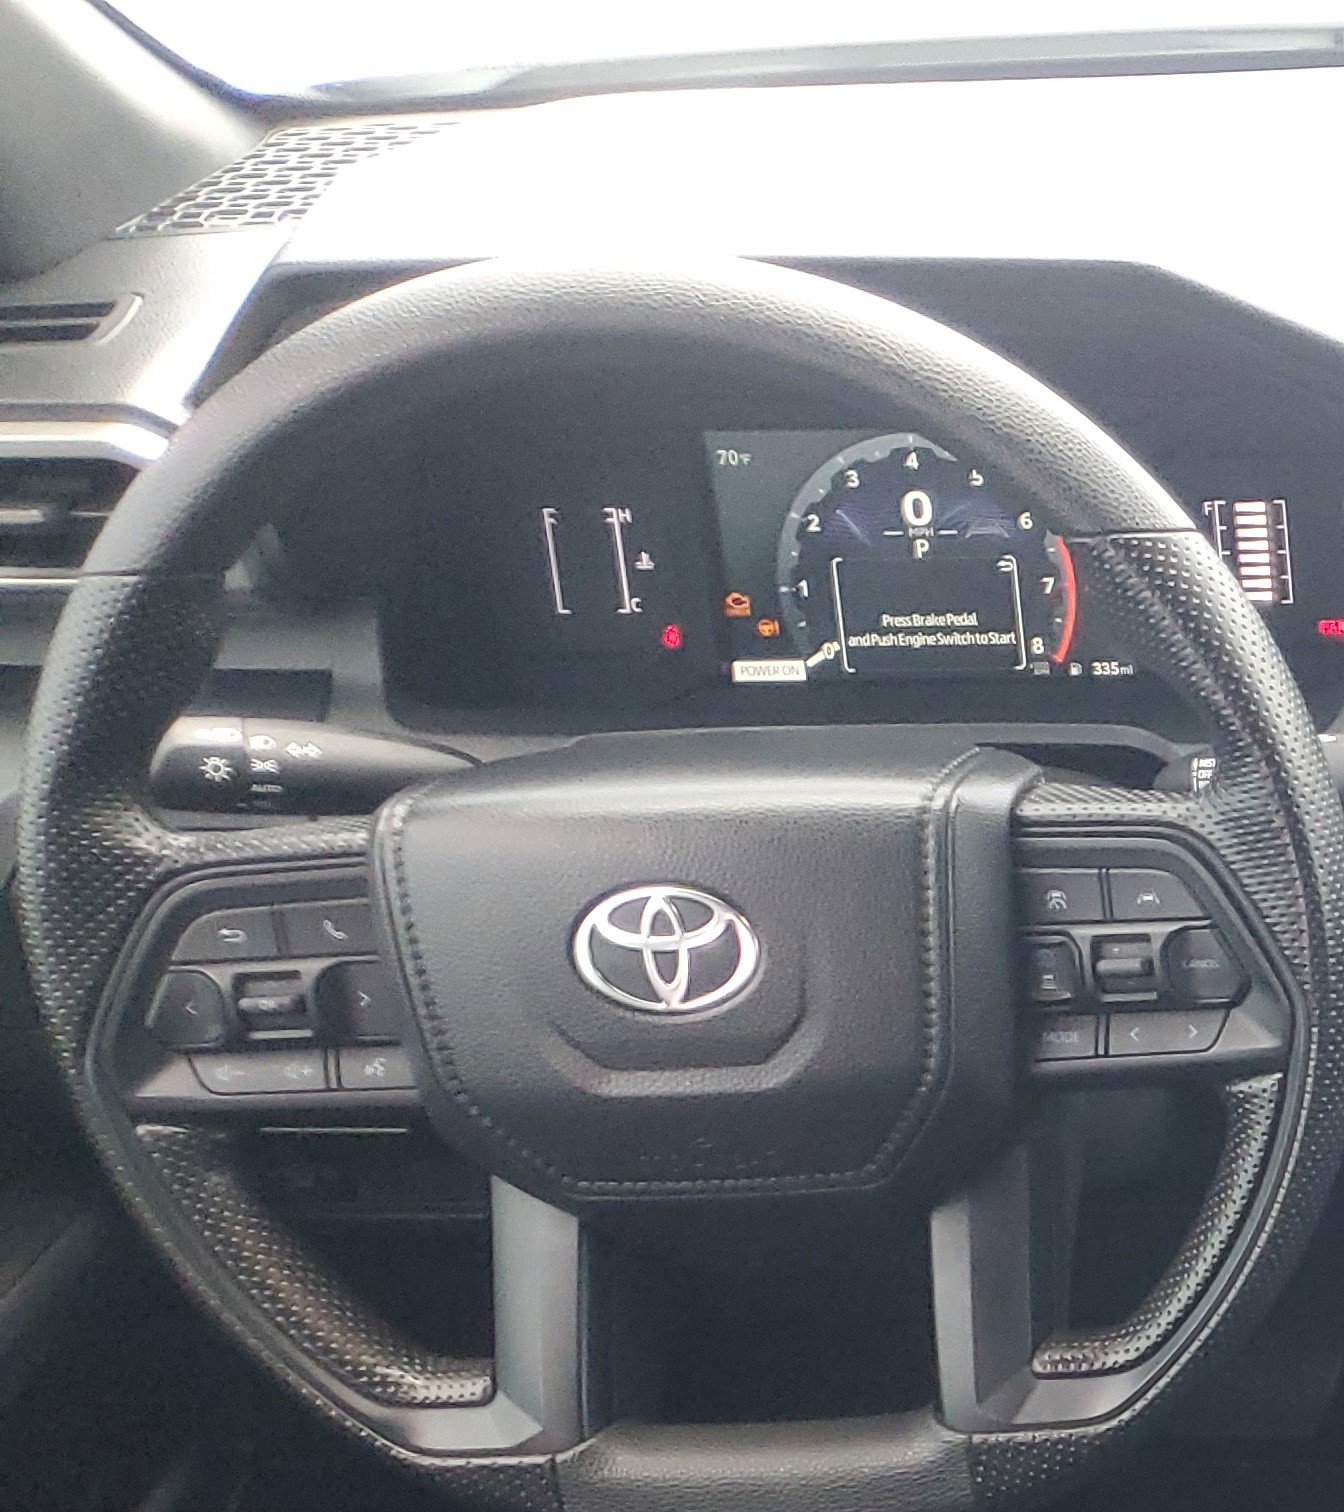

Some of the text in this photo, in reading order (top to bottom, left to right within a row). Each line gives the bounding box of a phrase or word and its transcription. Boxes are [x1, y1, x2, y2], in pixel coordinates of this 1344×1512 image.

[905, 451, 920, 470] 4
[844, 469, 861, 488] 3
[903, 490, 933, 526] 0
[806, 514, 822, 532] 2
[1018, 510, 1034, 530] 6
[914, 538, 930, 558] P
[1040, 576, 1055, 594] 7
[881, 612, 979, 627] Press Brake Pedal
[848, 630, 1017, 648] and Push Engine Switch to Start
[1030, 636, 1045, 654] 8
[740, 664, 801, 677] POWER ON
